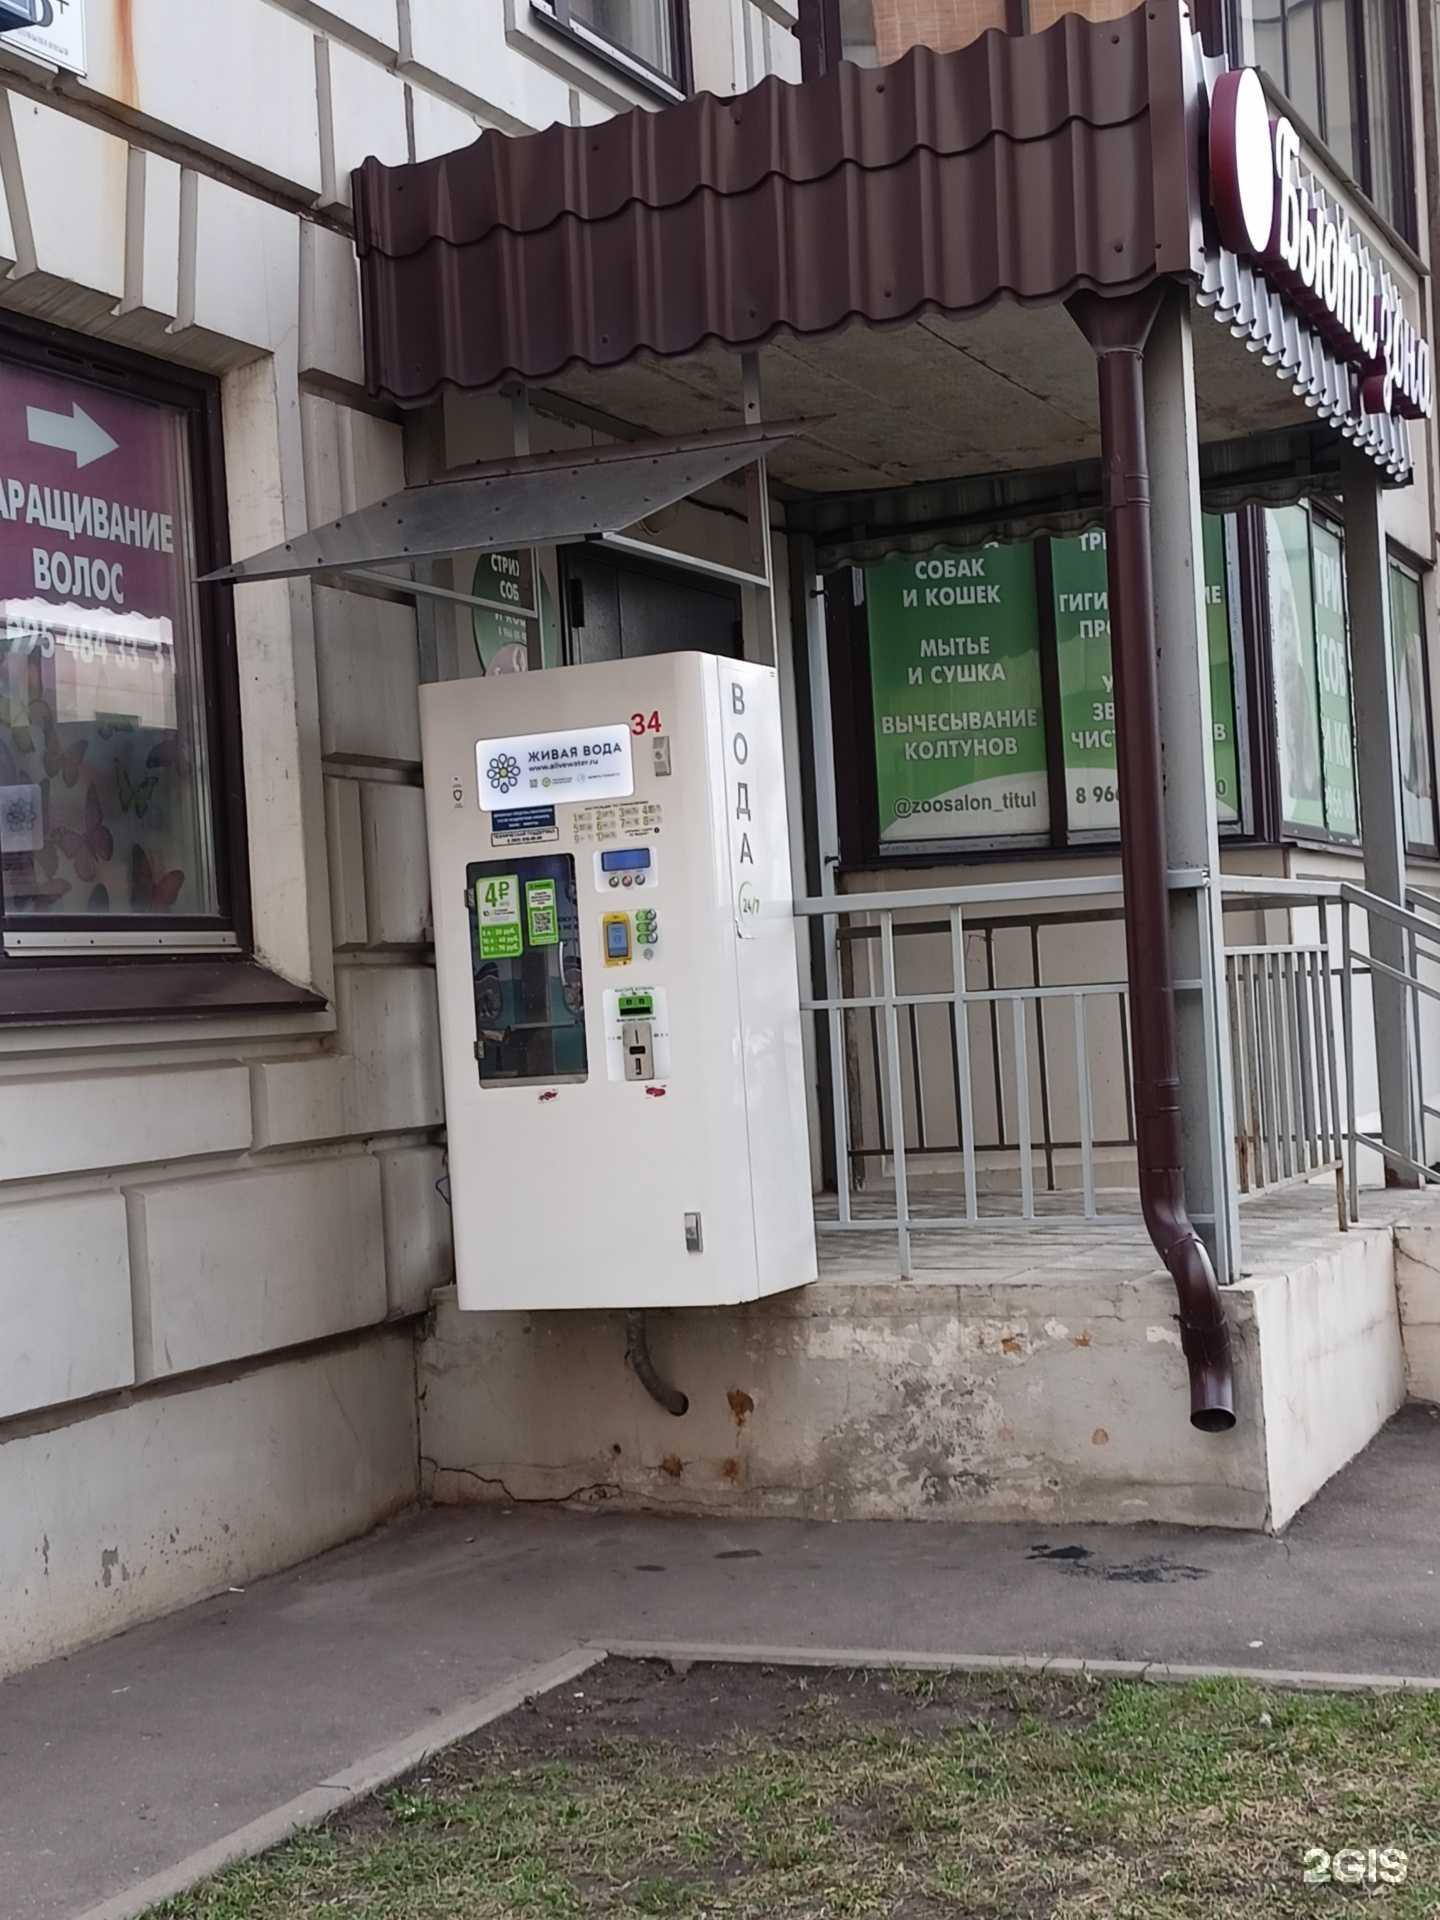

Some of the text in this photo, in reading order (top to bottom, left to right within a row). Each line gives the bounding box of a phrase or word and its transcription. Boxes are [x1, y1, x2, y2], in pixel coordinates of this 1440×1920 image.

[33, 548, 124, 604] ВОЛОС
[915, 559, 985, 579] СОБАК
[903, 585, 1000, 608] И КОШЕК
[1080, 619, 1110, 639] ПР
[920, 636, 990, 658] МЫТЬЕ
[908, 662, 1006, 685] И СУШКА
[631, 710, 662, 736] 34
[882, 709, 1038, 734] ВЫЧЕСЫВАНИЕ
[528, 743, 622, 763] ЖИВАЯ ВОДА
[905, 737, 1018, 761] КОЛТУНОВ
[895, 791, 1037, 818] @zoosalon_titul
[1076, 787, 1086, 804] 8
[742, 898, 760, 914] 24/7
